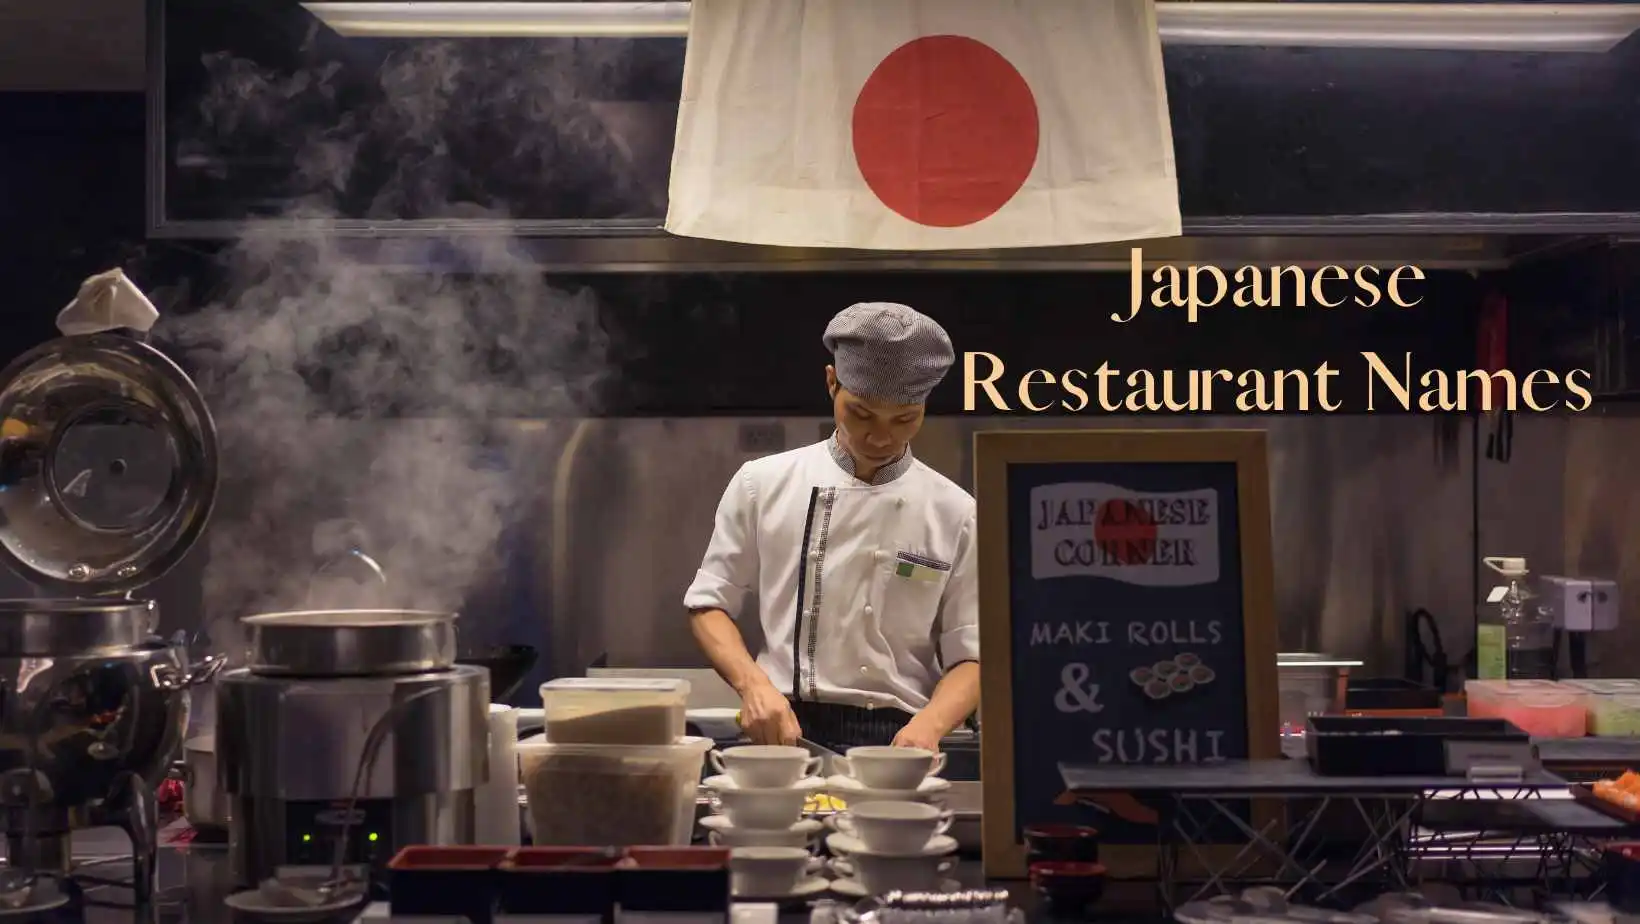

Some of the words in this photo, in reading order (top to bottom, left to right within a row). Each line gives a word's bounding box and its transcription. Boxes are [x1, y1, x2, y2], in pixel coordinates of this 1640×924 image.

[1037, 498, 1210, 530] JAPANESE
[1053, 538, 1195, 567] CORNER
[1030, 620, 1112, 646] MAKI
[1128, 620, 1223, 646] ROLLS
[1054, 662, 1104, 713] &
[1092, 728, 1227, 764] SUSHI
